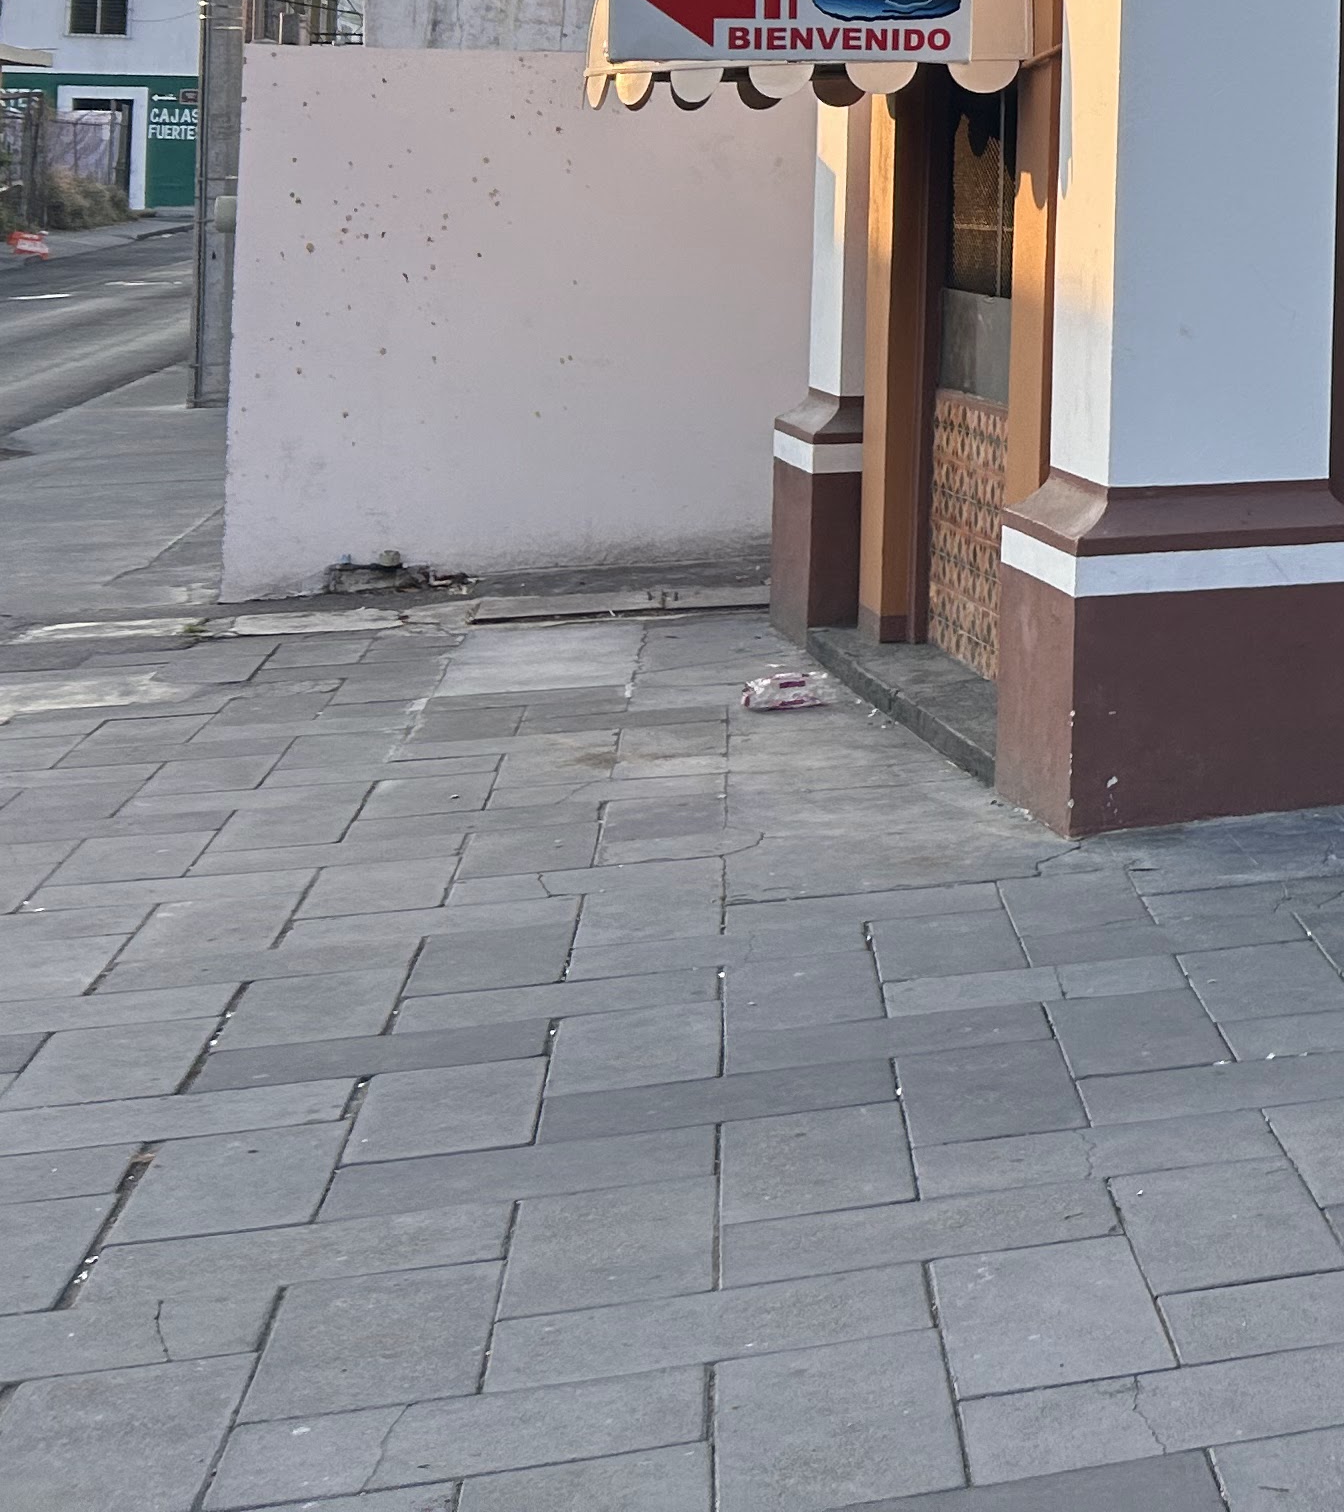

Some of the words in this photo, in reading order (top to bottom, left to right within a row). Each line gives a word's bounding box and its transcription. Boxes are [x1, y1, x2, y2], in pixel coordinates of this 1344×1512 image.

[727, 26, 952, 51] BIENVENIDO
[150, 108, 199, 123] CAJAS
[148, 125, 197, 140] FUERTE
